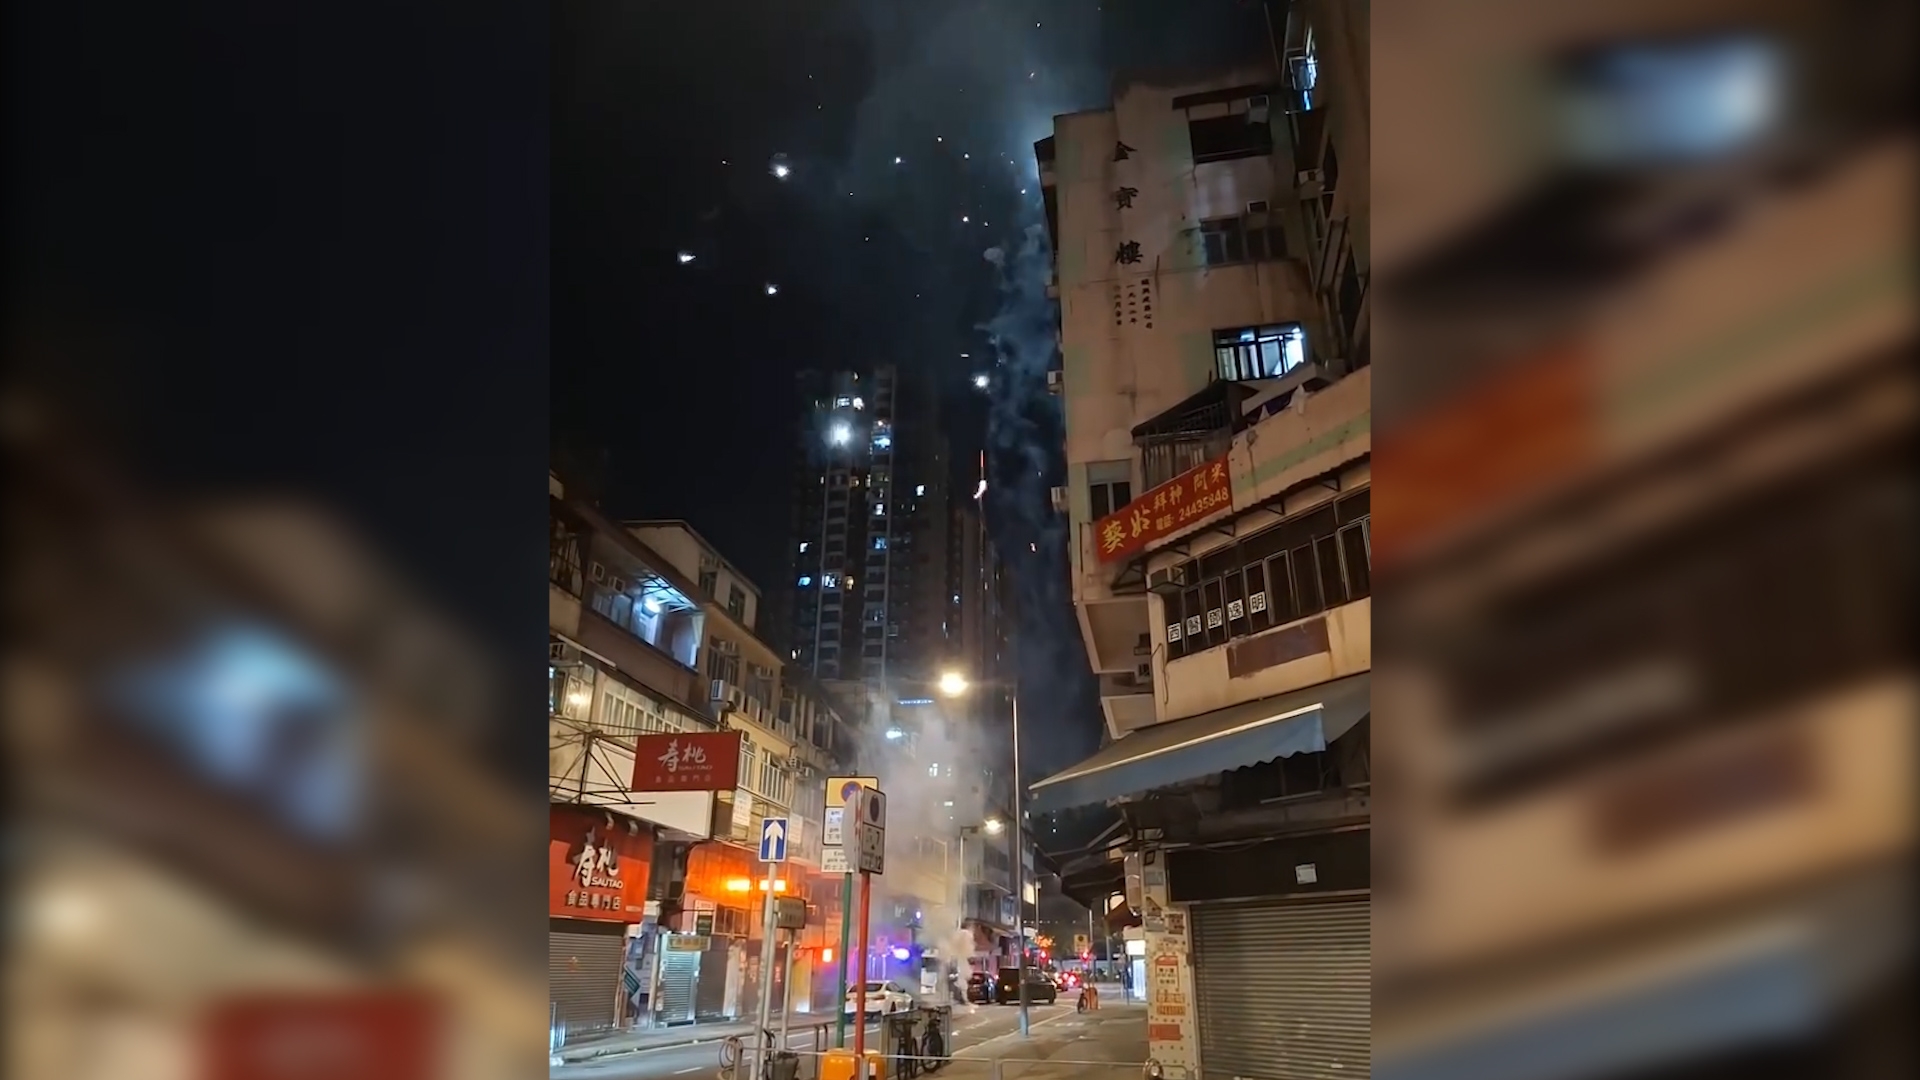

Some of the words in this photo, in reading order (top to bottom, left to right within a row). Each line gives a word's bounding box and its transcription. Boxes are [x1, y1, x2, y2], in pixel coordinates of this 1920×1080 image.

[1153, 485, 1183, 512] 拜神
[591, 877, 624, 889] SAUTAO
[567, 890, 622, 910] 食品專門店
